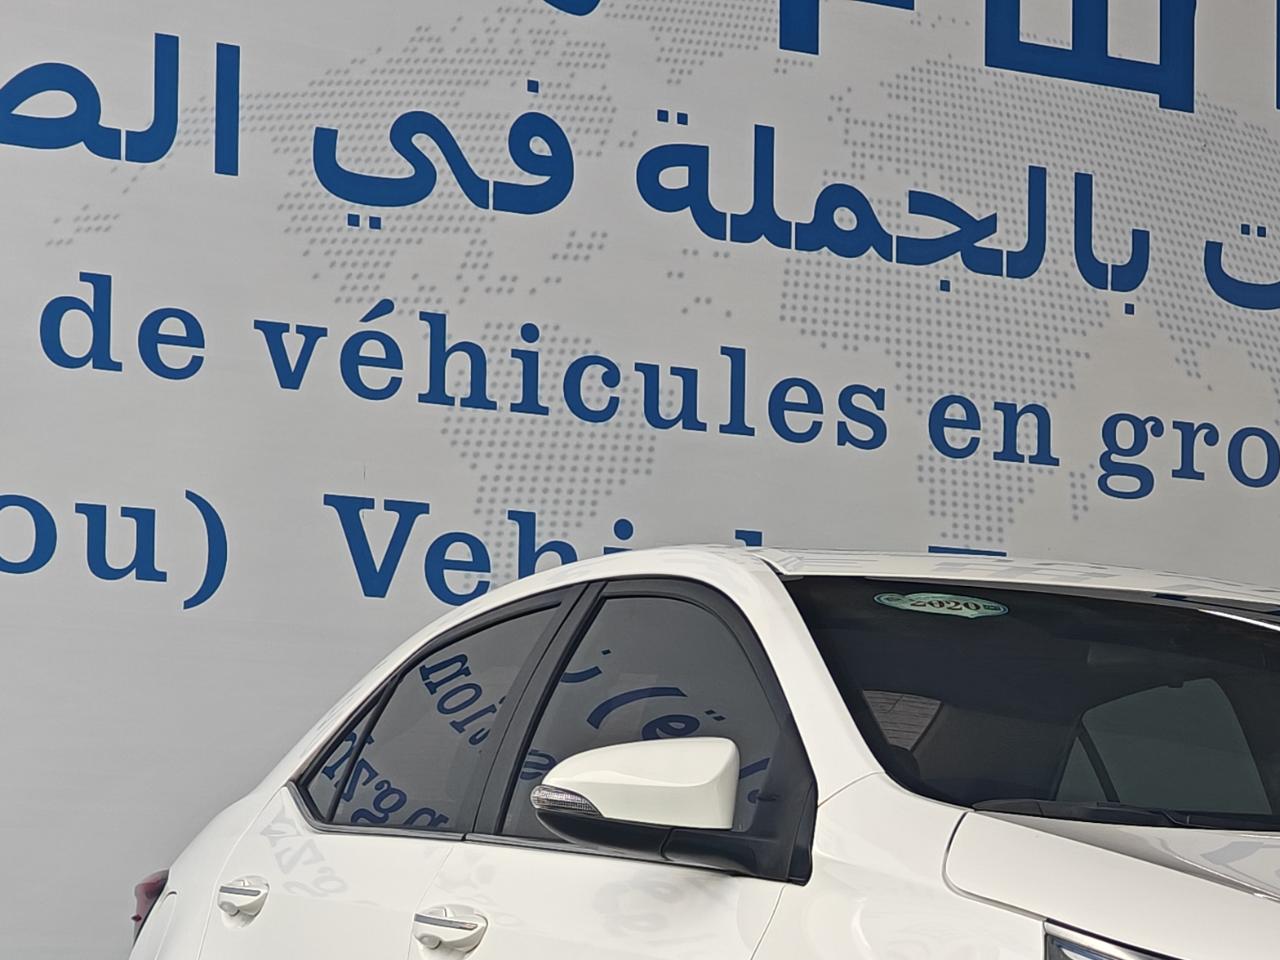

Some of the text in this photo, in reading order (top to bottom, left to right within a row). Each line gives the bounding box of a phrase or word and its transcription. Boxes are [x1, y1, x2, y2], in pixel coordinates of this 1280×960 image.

[312, 79, 576, 231] في
[635, 109, 1151, 317] بالجملة
[39, 271, 206, 381] de
[253, 298, 888, 450] véhicules
[928, 394, 1061, 467] en
